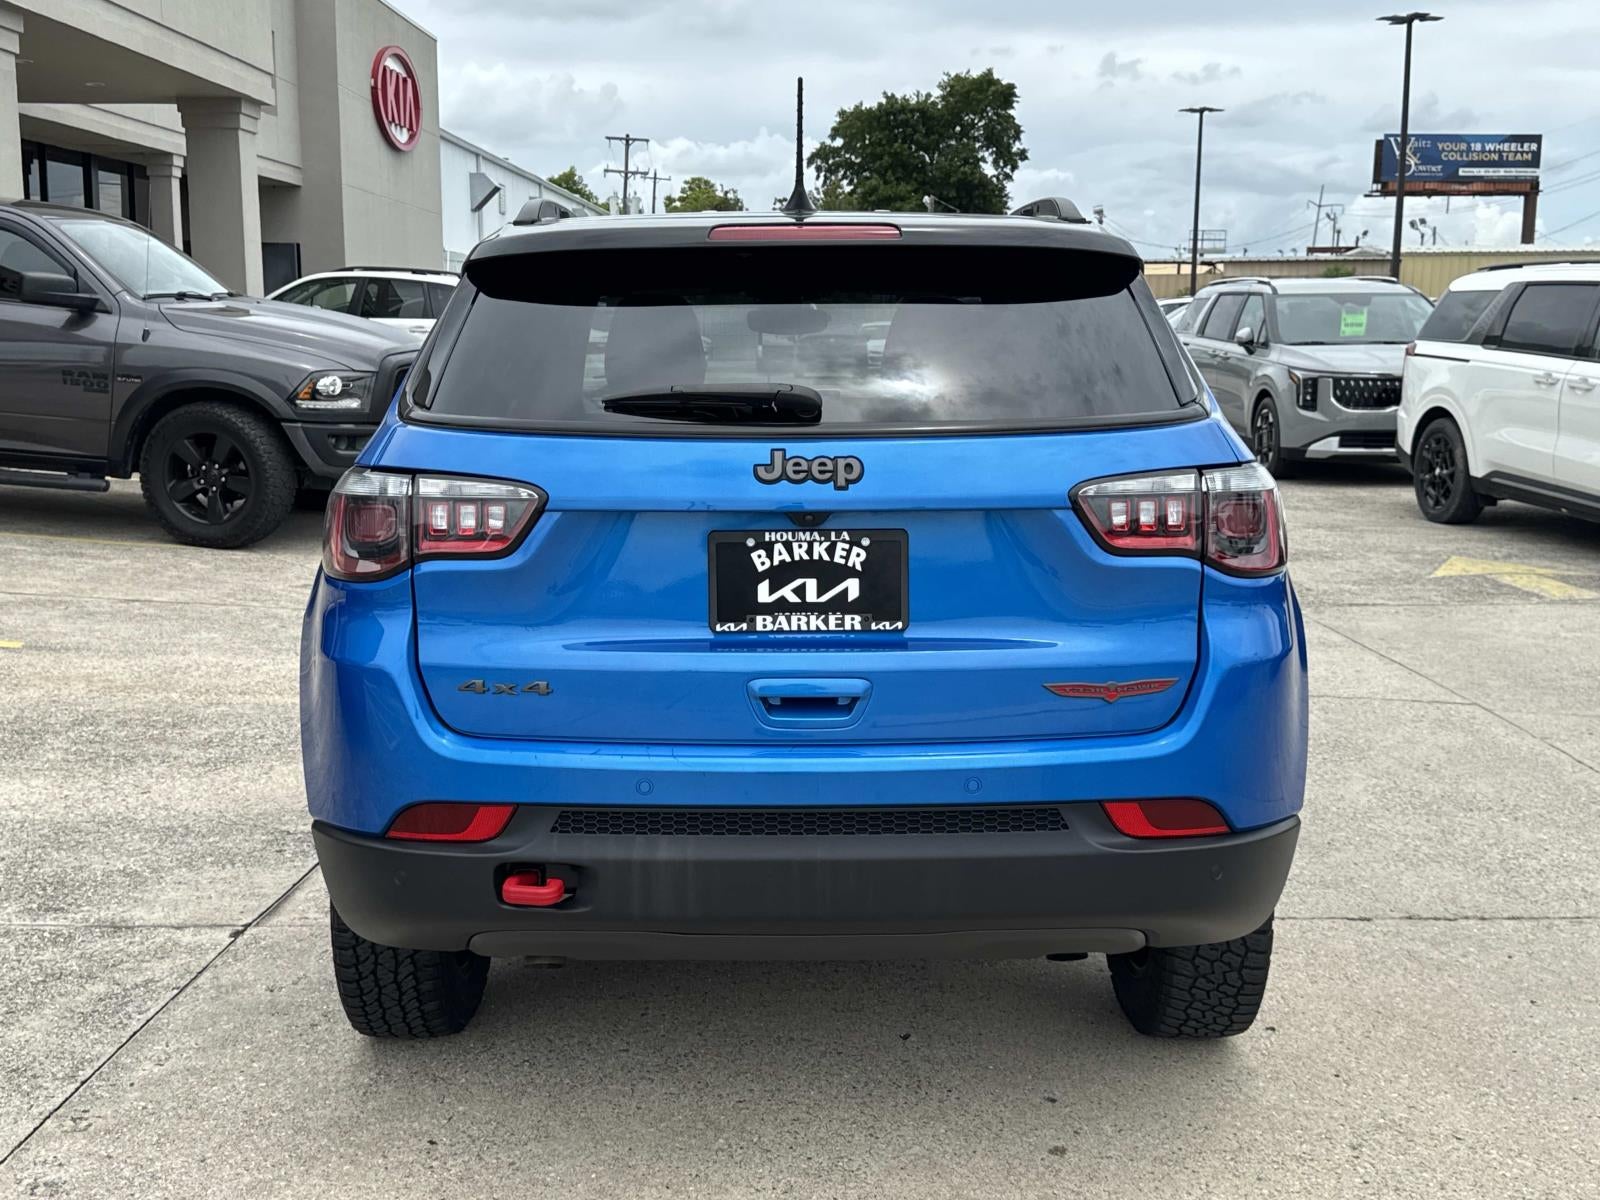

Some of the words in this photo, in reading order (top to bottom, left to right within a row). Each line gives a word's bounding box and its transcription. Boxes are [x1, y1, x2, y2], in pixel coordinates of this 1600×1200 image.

[385, 65, 417, 132] KIA
[1437, 142, 1467, 151] YOUR
[1470, 142, 1482, 151] 18
[1484, 142, 1538, 152] WHEELER
[1441, 152, 1499, 161] COLLISION
[1502, 152, 1532, 161] TEAM
[61, 369, 109, 381] RAM
[62, 378, 109, 389] 1500
[754, 448, 864, 490] Jeep
[764, 531, 825, 541] HOUMA,
[831, 531, 850, 541] LA
[750, 541, 867, 573] BARKER
[757, 578, 860, 603] KIA
[715, 622, 747, 631] KIA
[755, 614, 862, 631] BARKER
[871, 621, 902, 630] KIA
[457, 679, 553, 696] 4x4
